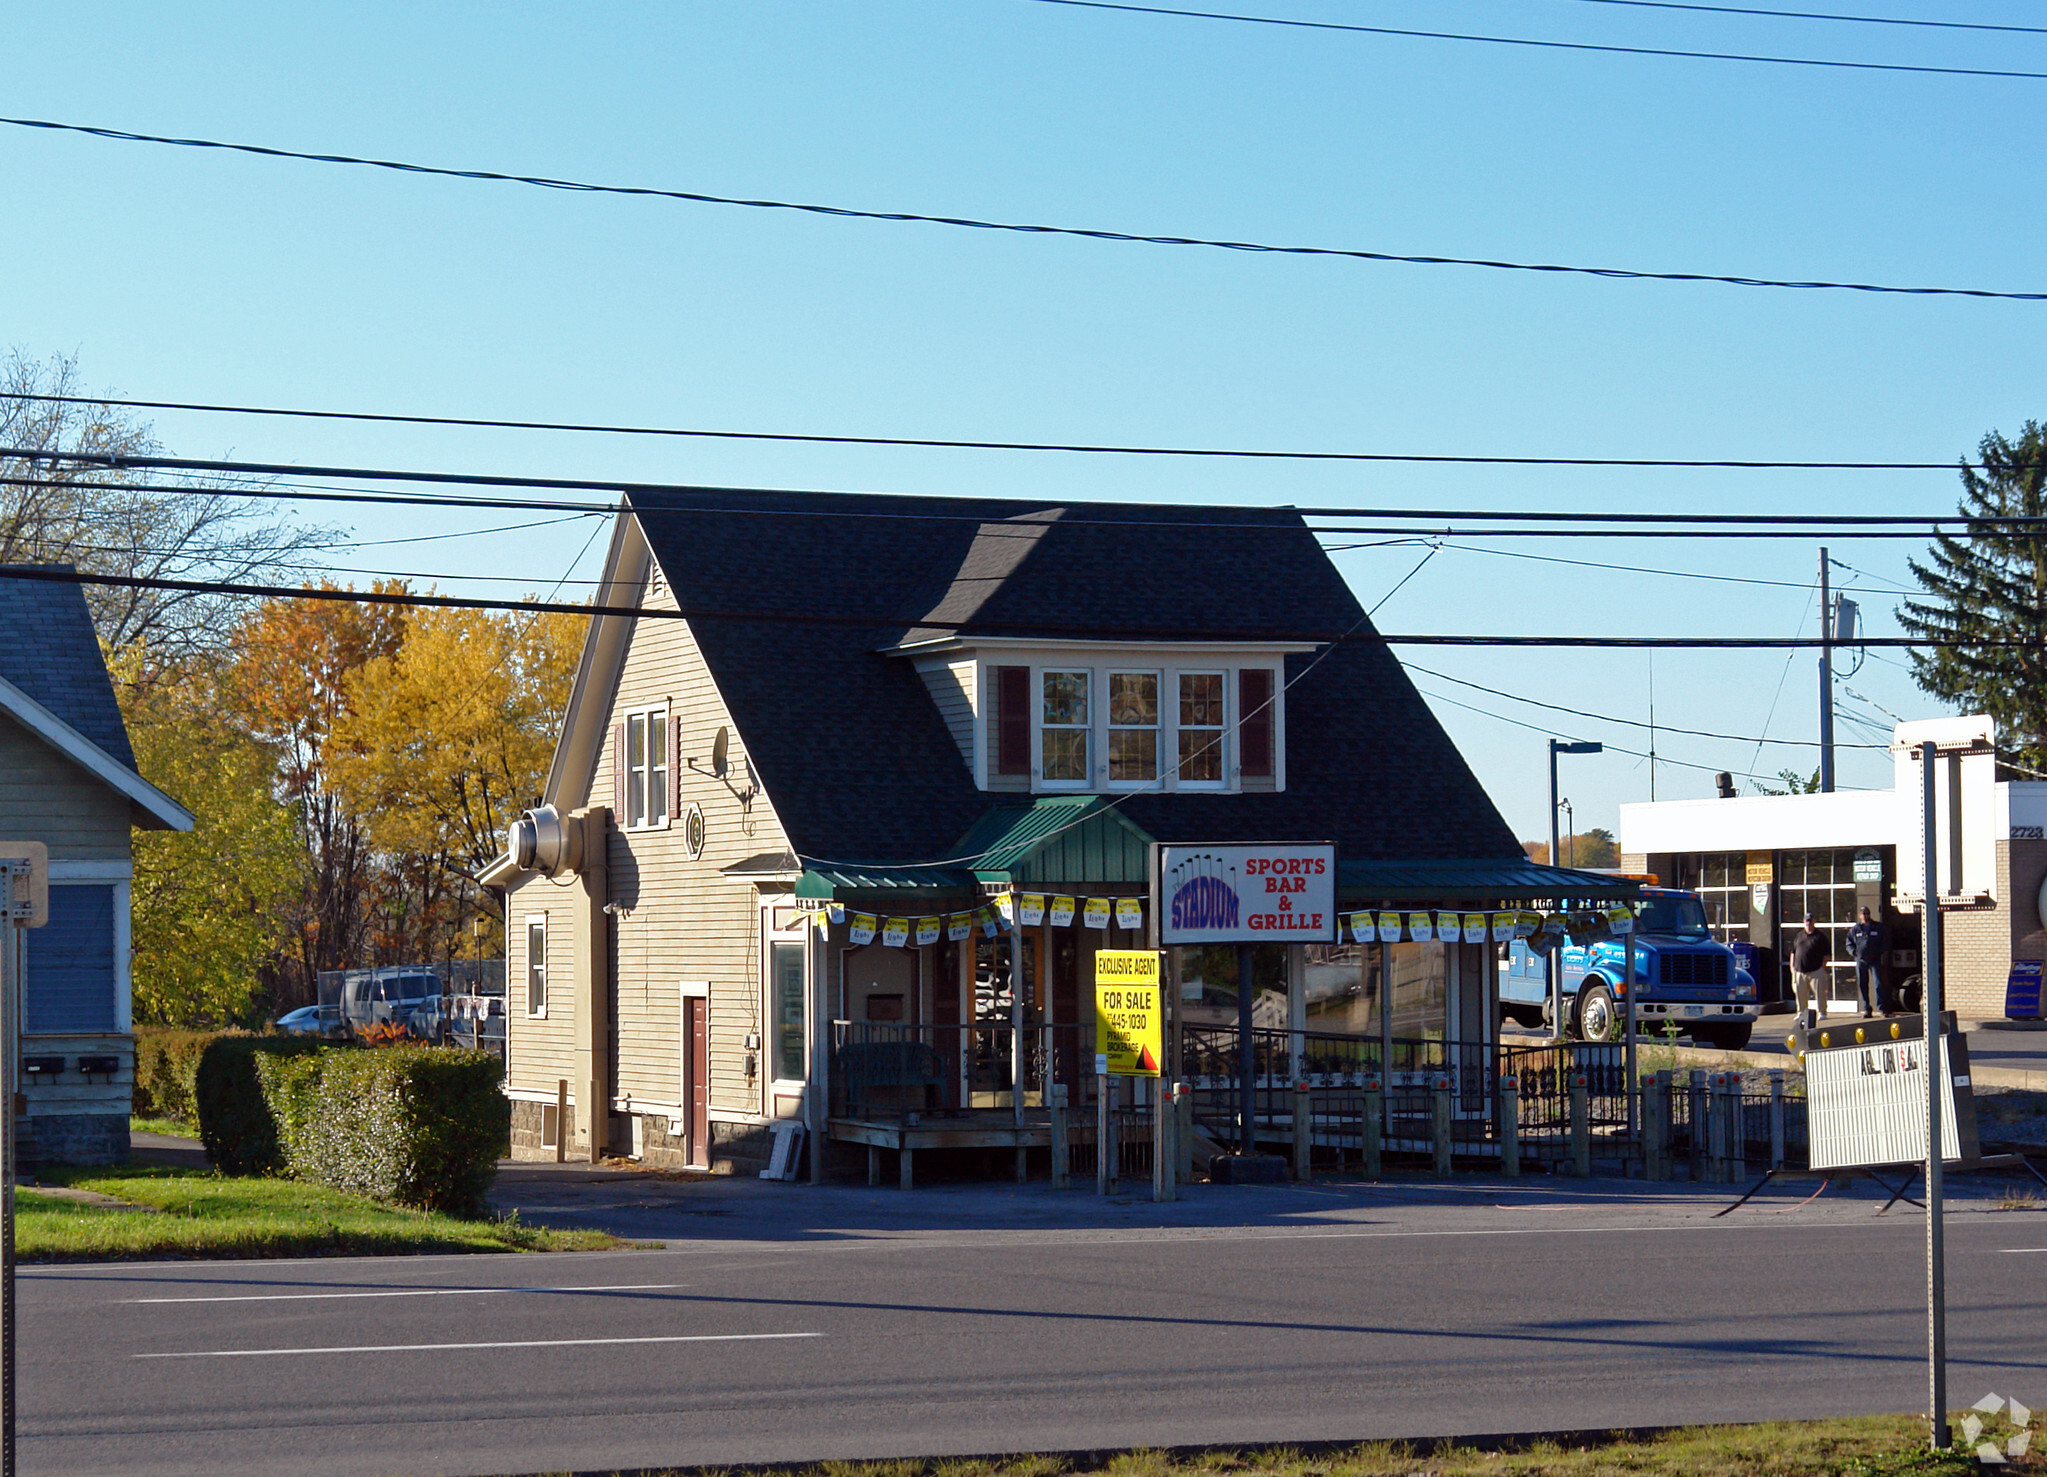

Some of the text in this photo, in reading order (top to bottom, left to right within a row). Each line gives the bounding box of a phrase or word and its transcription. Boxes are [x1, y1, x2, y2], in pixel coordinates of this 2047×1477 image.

[2011, 826, 2044, 838] 2723
[1246, 858, 1325, 875] SPORTS
[1265, 877, 1307, 893] BAR
[1171, 875, 1240, 931] STADIUM
[1278, 895, 1292, 911] &
[1247, 913, 1323, 930] GRILLE
[1098, 957, 1156, 975] EXCLUSIVE AGENT
[1103, 991, 1151, 1009] FOR SALE
[1111, 1013, 1146, 1030] 445-1030
[1106, 1031, 1131, 1042] PYRAMID
[1106, 1042, 1139, 1053] BROKERAGE
